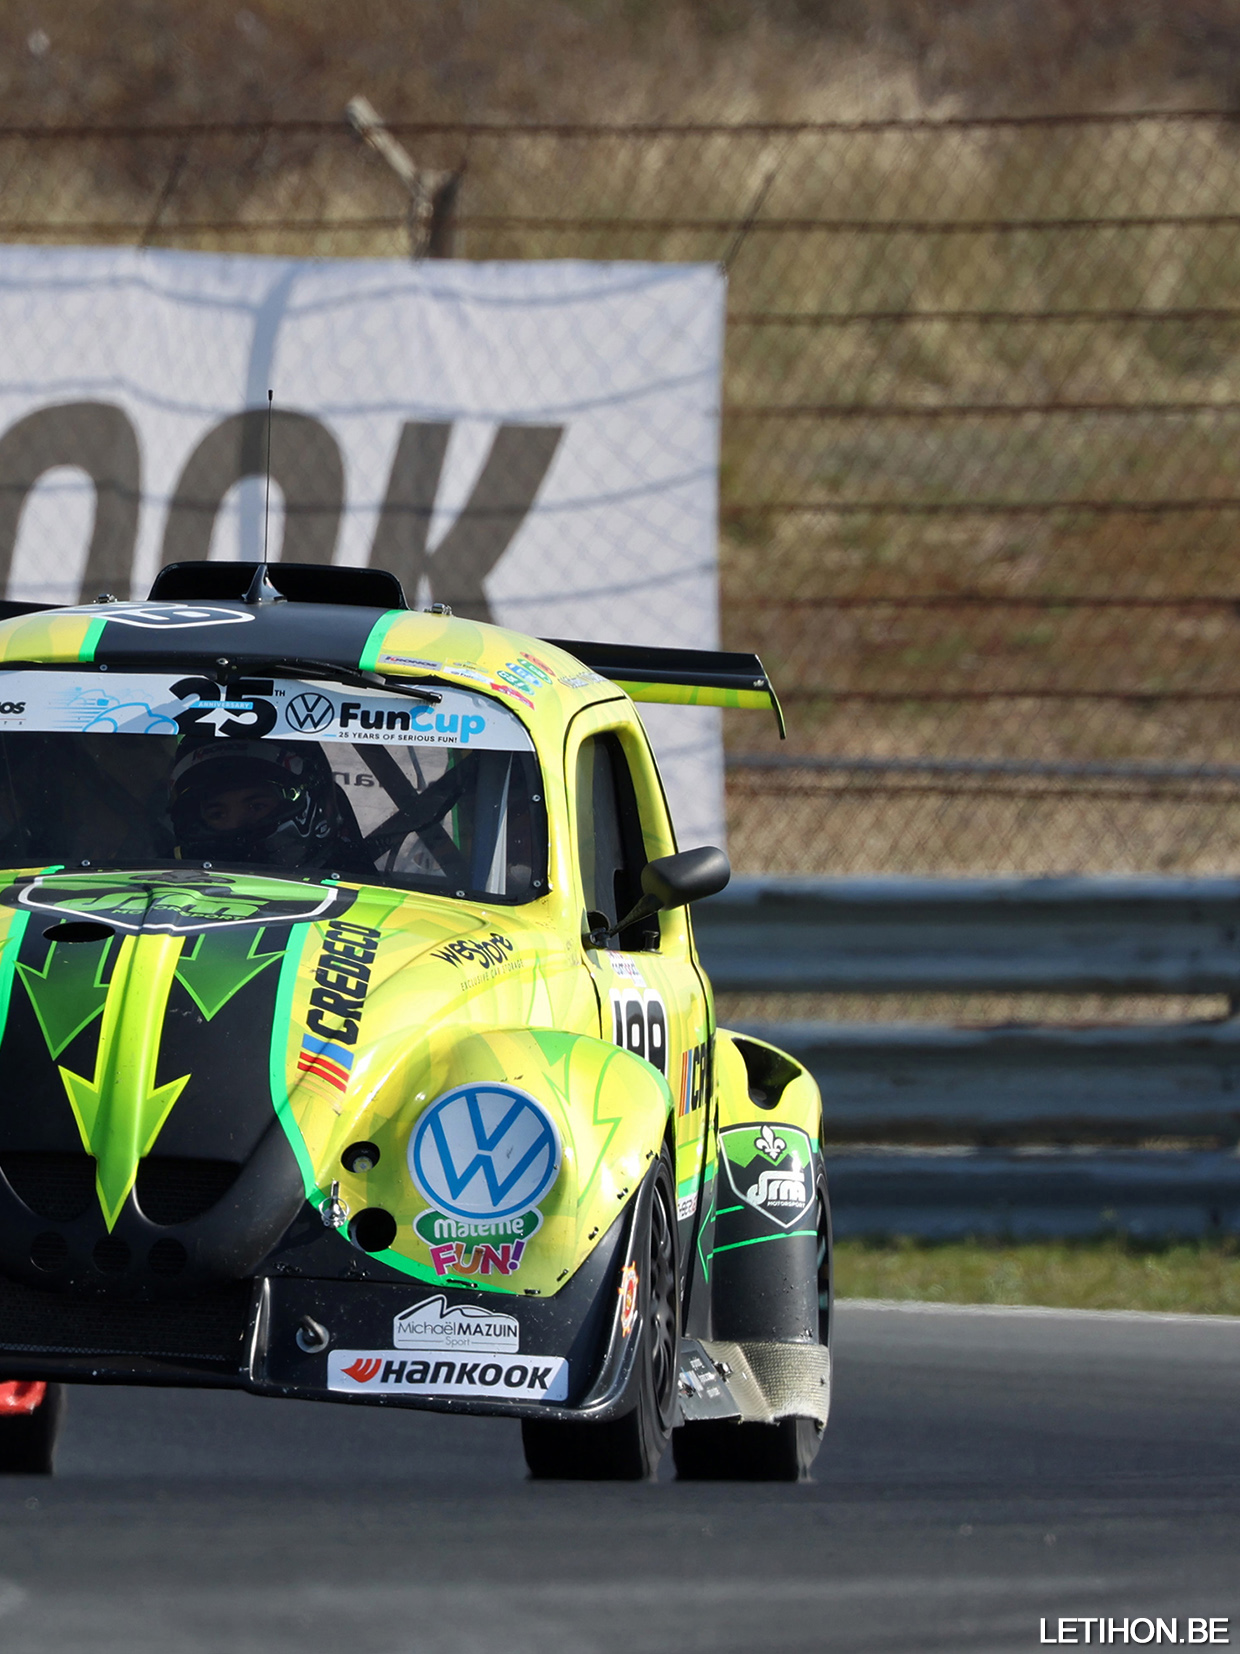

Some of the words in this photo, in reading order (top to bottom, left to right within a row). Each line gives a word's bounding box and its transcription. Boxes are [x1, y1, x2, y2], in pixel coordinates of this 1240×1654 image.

[273, 689, 286, 698] TH
[169, 677, 278, 738] 25
[338, 731, 350, 739] 25
[352, 732, 380, 740] YEARS
[383, 733, 395, 741] OF
[398, 733, 435, 743] SERIOUS
[437, 736, 458, 744] FUN!
[306, 920, 382, 1046] CREDECO
[429, 1238, 526, 1276] FUN!
[445, 1336, 470, 1348] Sport
